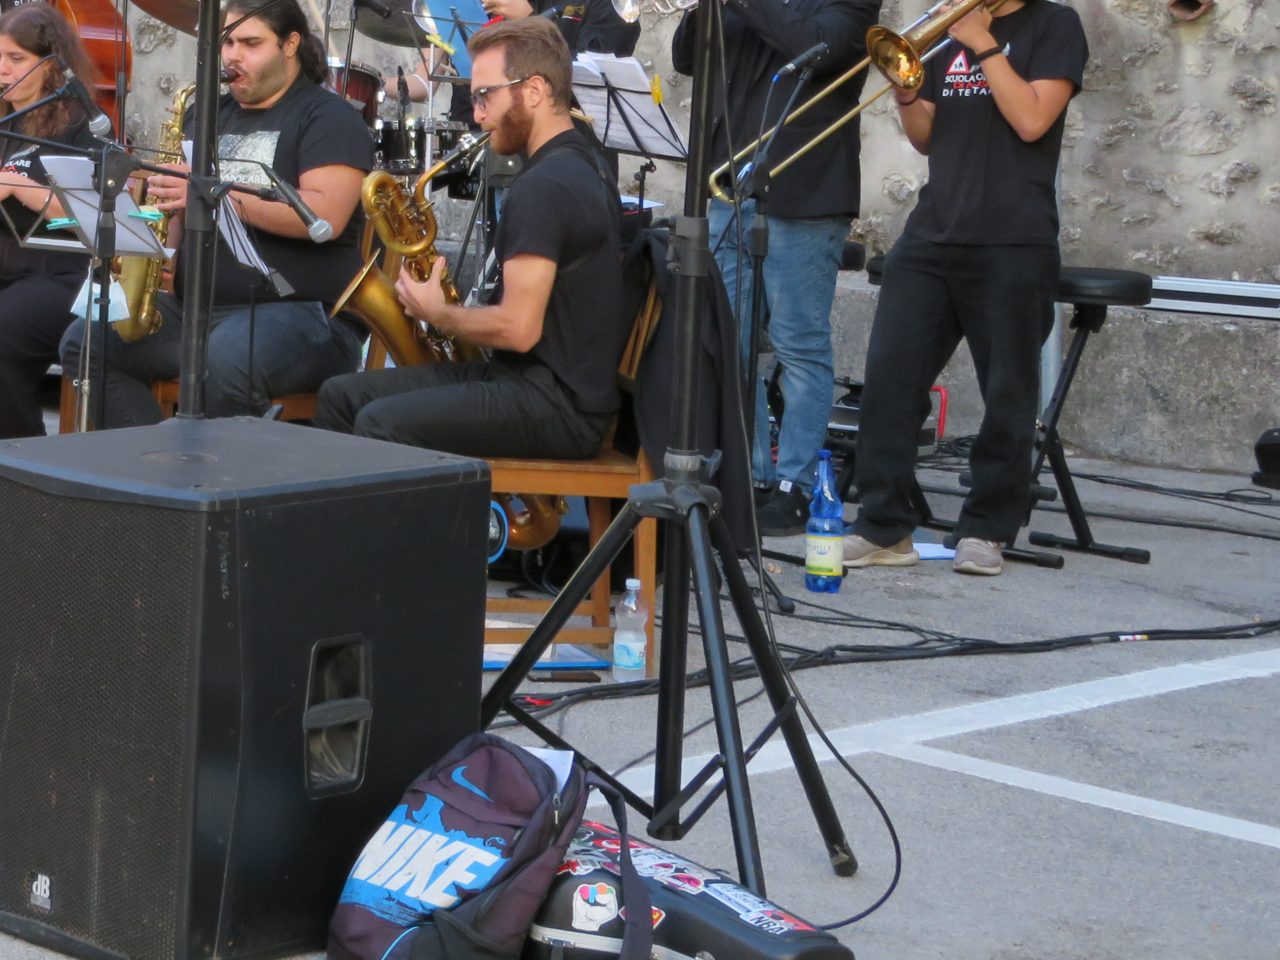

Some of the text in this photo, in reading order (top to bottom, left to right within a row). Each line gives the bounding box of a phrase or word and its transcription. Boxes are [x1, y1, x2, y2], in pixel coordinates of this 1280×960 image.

[944, 74, 976, 84] SCUOLA
[352, 820, 500, 909] NIKE
[32, 873, 51, 898] dB
